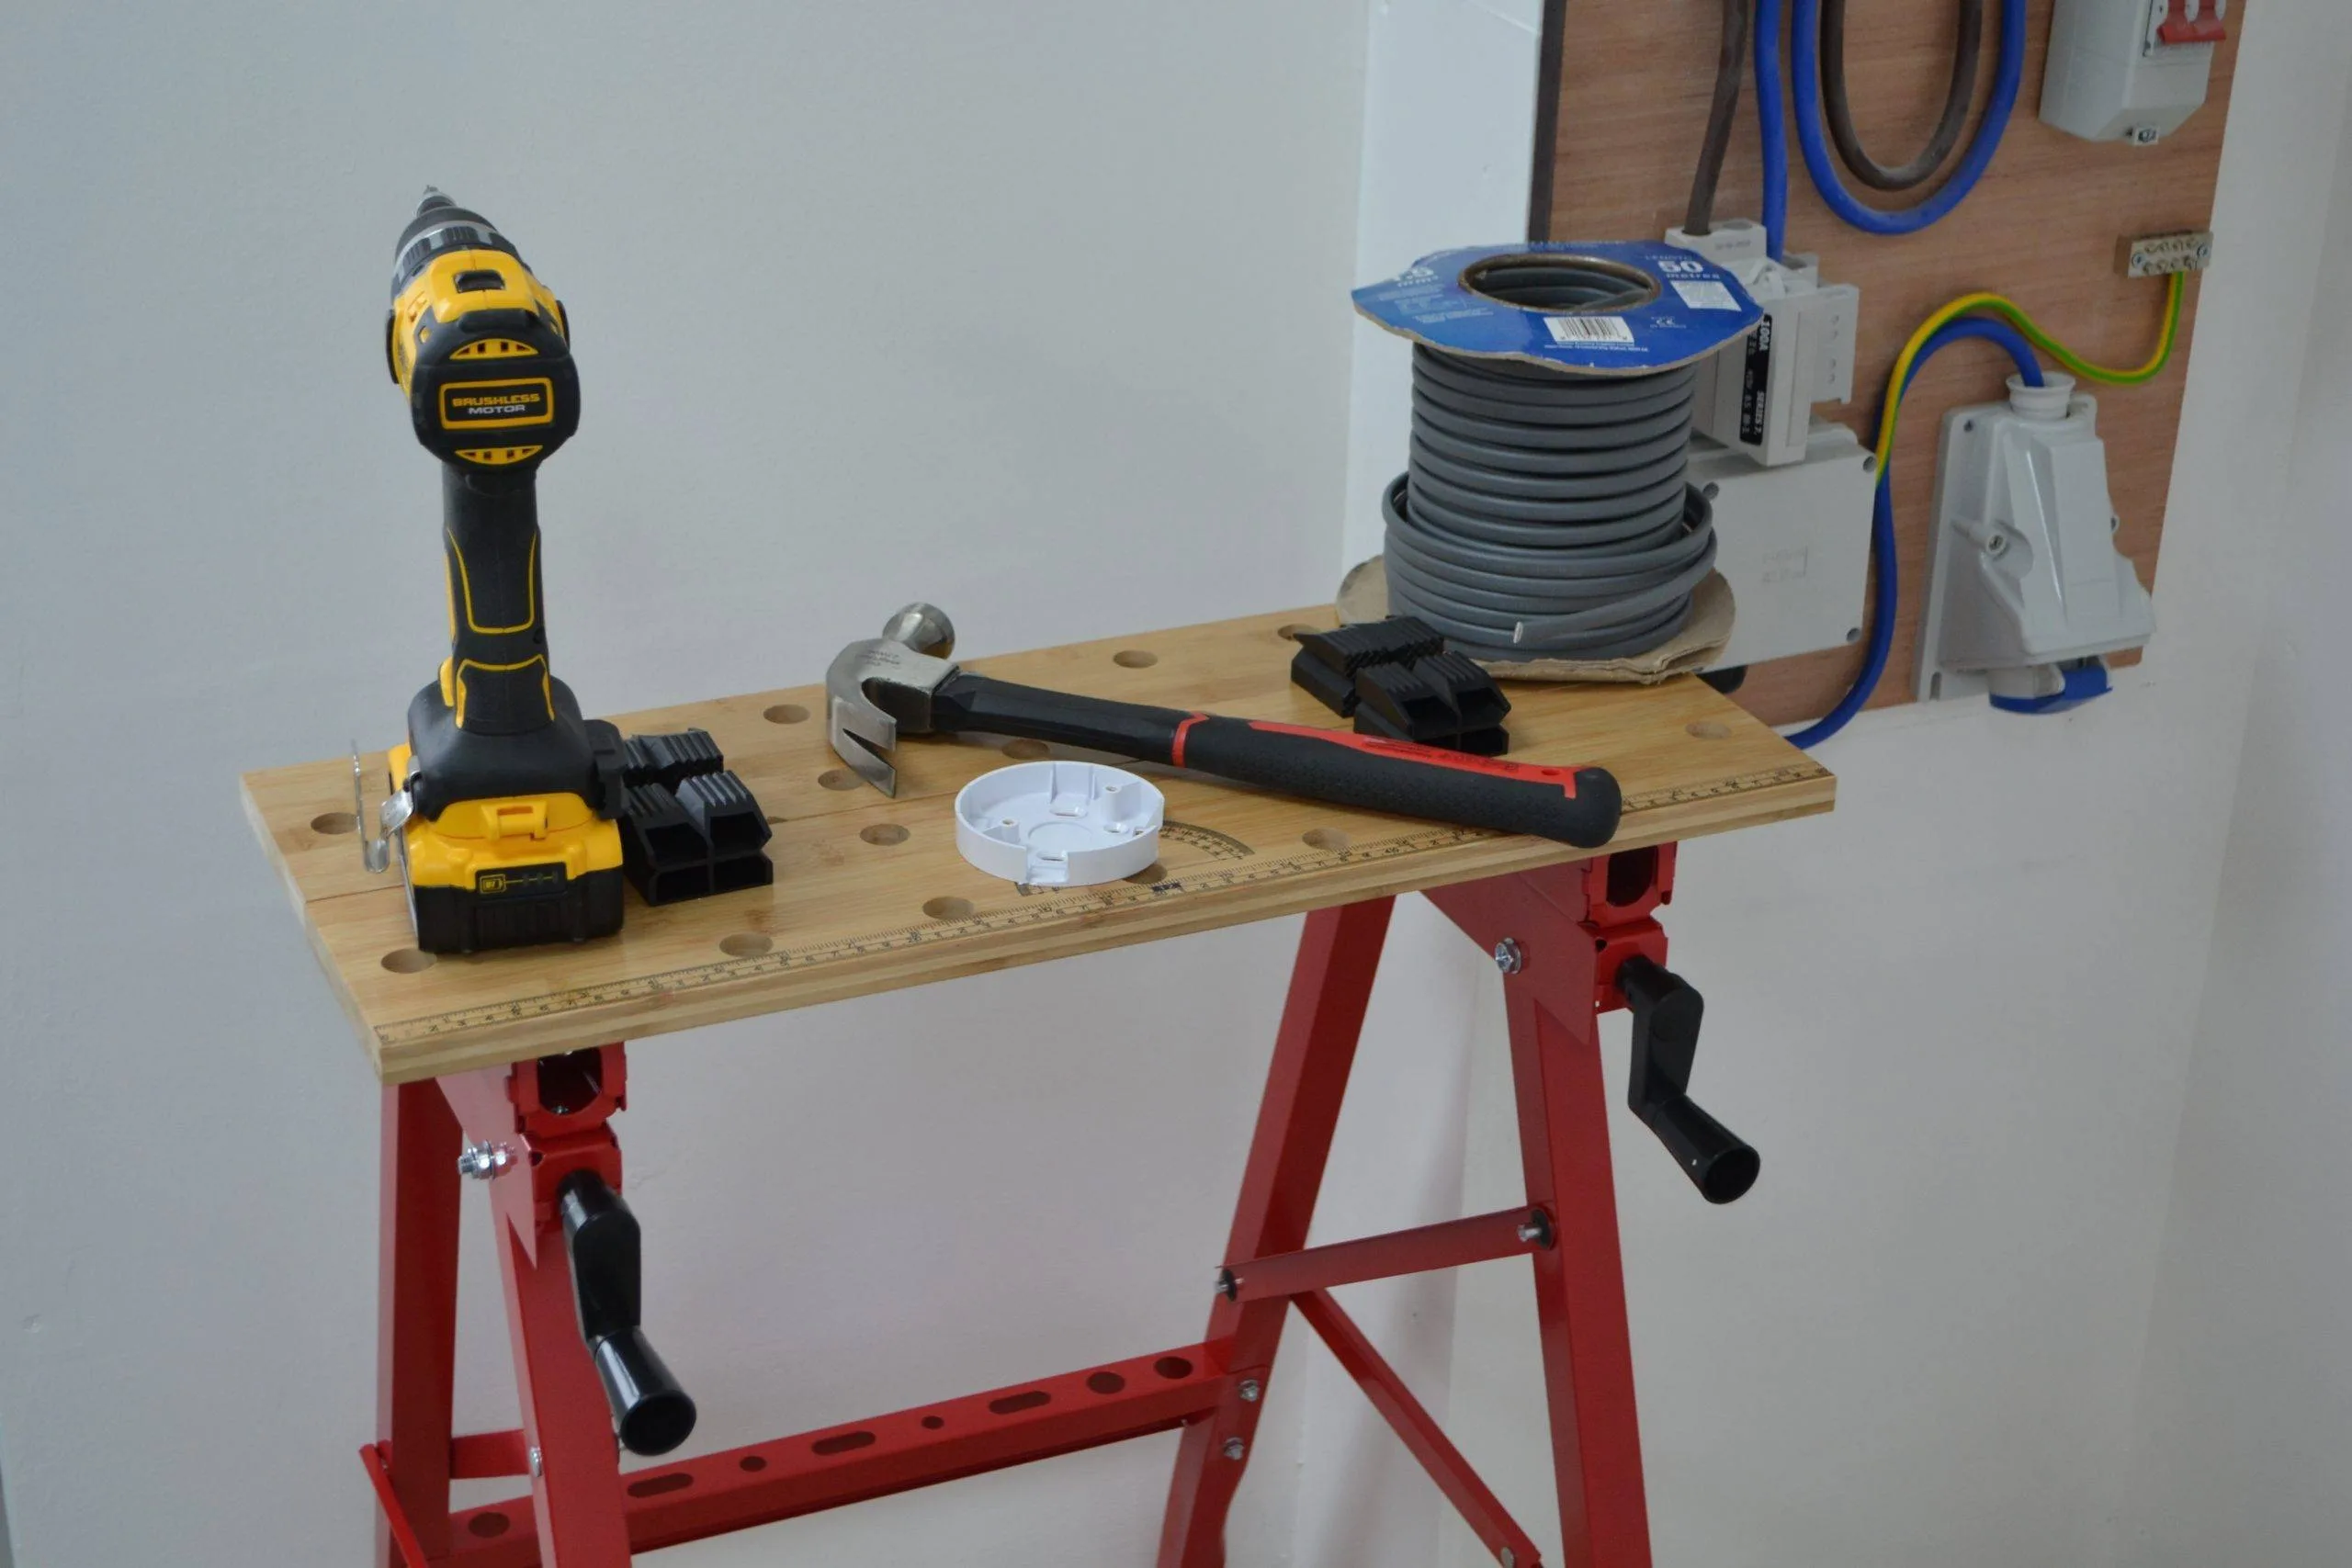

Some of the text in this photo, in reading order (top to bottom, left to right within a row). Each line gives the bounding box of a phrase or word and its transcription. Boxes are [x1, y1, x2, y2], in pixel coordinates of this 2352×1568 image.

[1657, 259, 1703, 274] 50
[452, 393, 540, 406] BRUSHLESS
[468, 405, 526, 414] MOTOR
